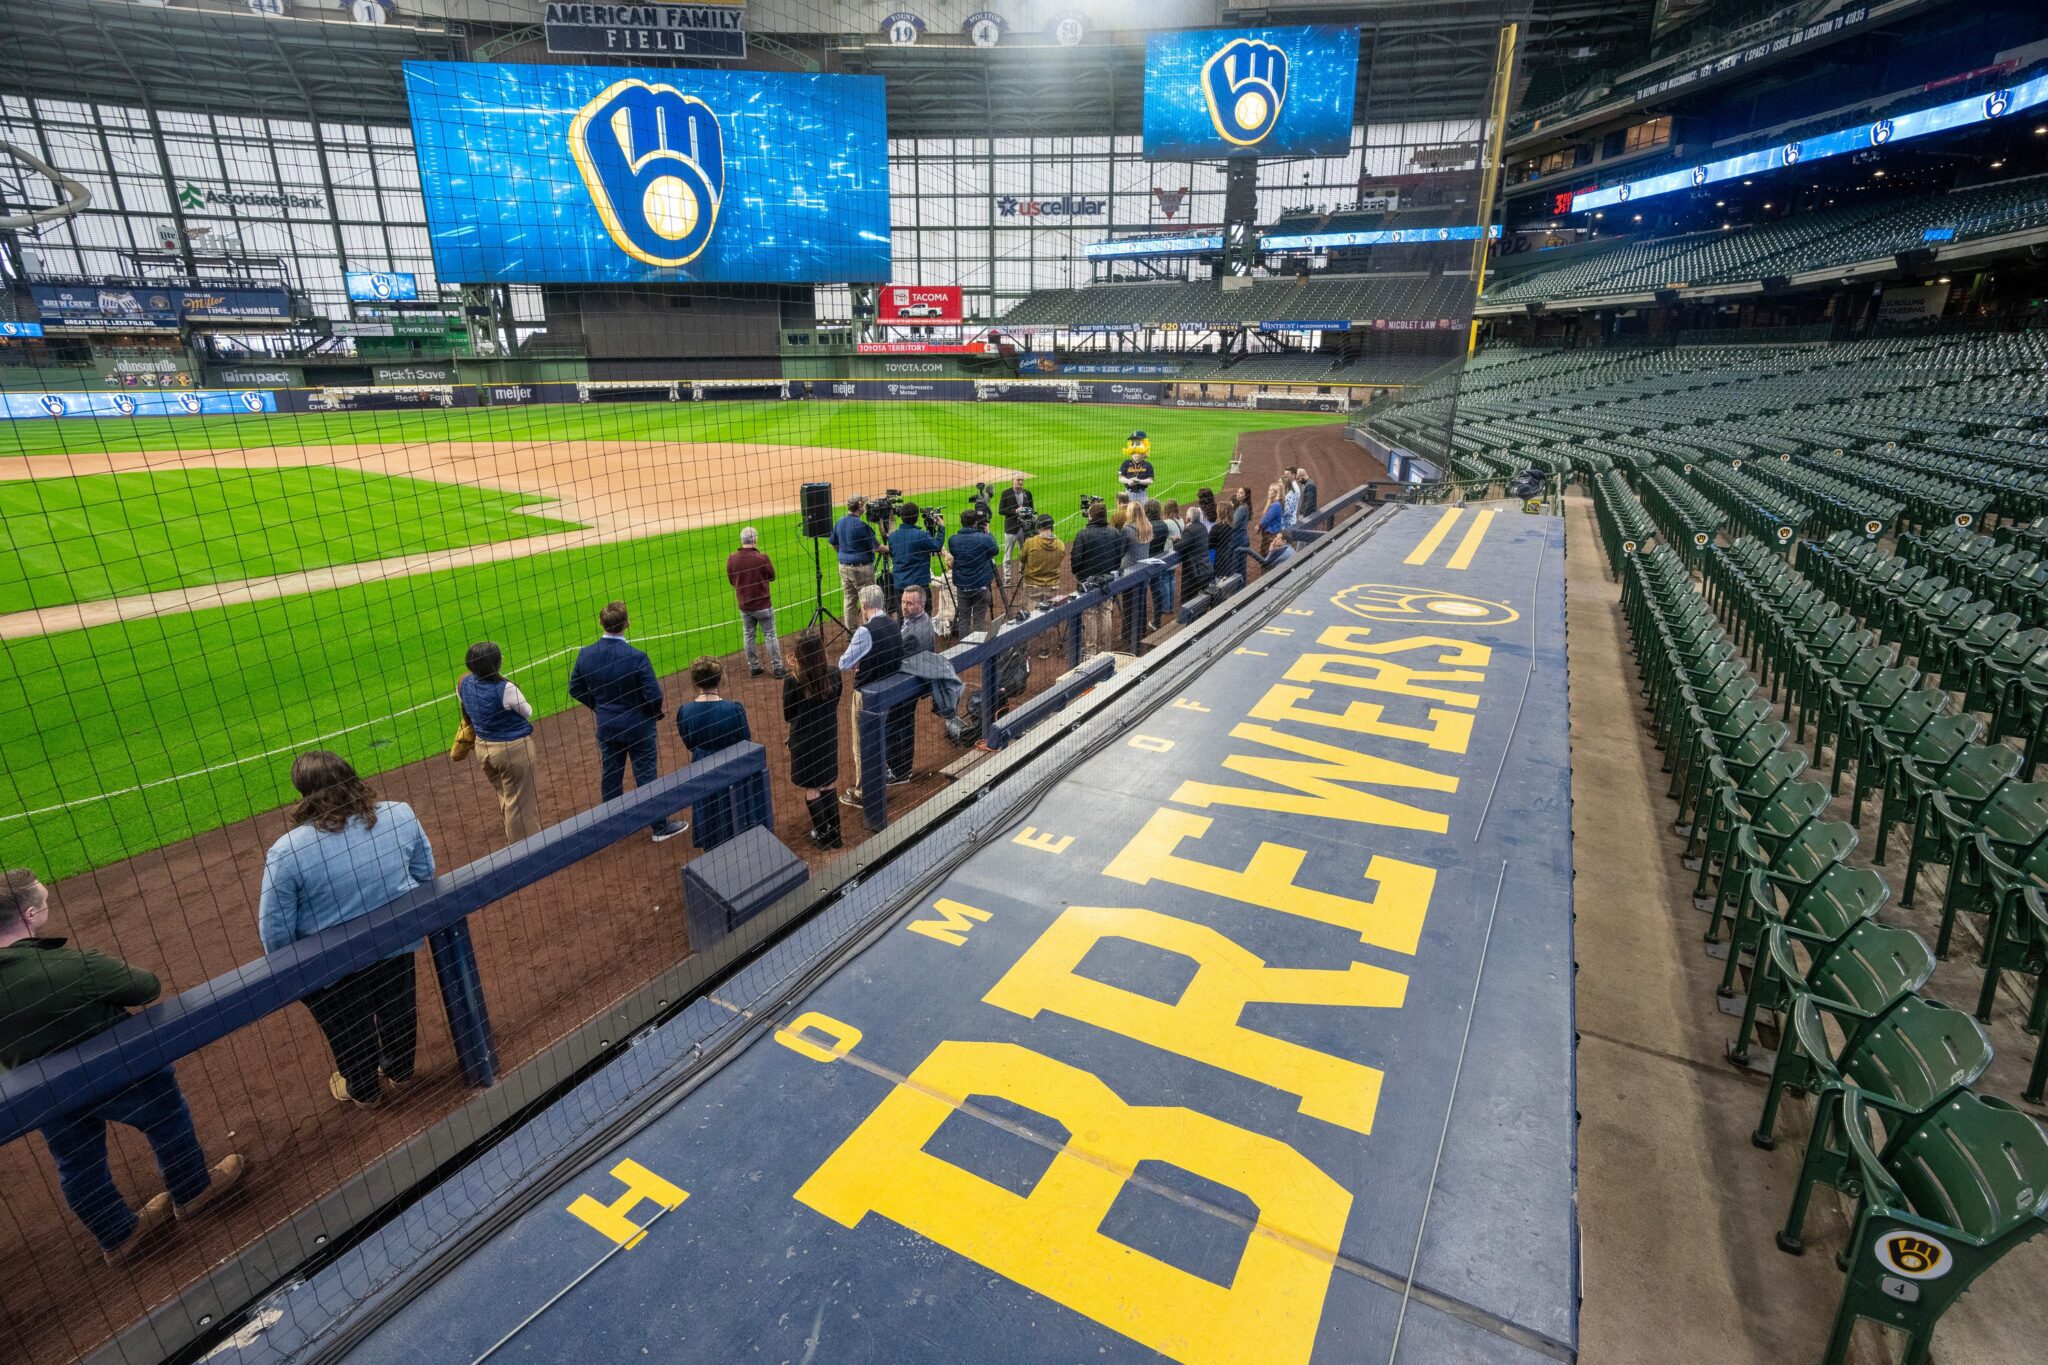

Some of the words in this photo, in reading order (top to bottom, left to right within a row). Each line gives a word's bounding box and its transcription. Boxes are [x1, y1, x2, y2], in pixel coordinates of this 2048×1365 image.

[546, 4, 657, 26] AMERICAN
[666, 8, 742, 29] FAMILY
[891, 12, 916, 22] YOUNT
[969, 12, 1001, 25] MOLITOR
[894, 26, 913, 43] 19
[978, 26, 991, 43] 4
[1804, 21, 1834, 41] LOCATION
[606, 29, 686, 50] FIELD
[206, 190, 289, 208] Associated
[289, 194, 326, 210] Bank
[60, 293, 73, 301] GO
[911, 293, 949, 302] TACOMA
[42, 300, 68, 308] BREW
[68, 300, 92, 308] CREW
[182, 297, 225, 312] Miller
[232, 307, 280, 315] MILWAUKEE
[1160, 323, 1178, 331] 620
[1180, 322, 1207, 331] WTMJ
[1261, 321, 1296, 330] WINTRUST
[1389, 319, 1419, 330] NICOLET
[1420, 319, 1436, 329] LAW
[113, 359, 177, 373] Johnsonville
[885, 363, 943, 372] TOYOTA.COM
[234, 368, 290, 384] impact
[416, 370, 446, 379] Save
[495, 385, 533, 402] meijer
[833, 381, 856, 397] meijer
[394, 393, 419, 402] Fleet
[309, 402, 358, 410] CHEVOLET
[1127, 697, 1212, 753] OF
[1233, 607, 1315, 658] THE
[793, 625, 1493, 1365] BREWERS
[1894, 1283, 1905, 1296] 4
